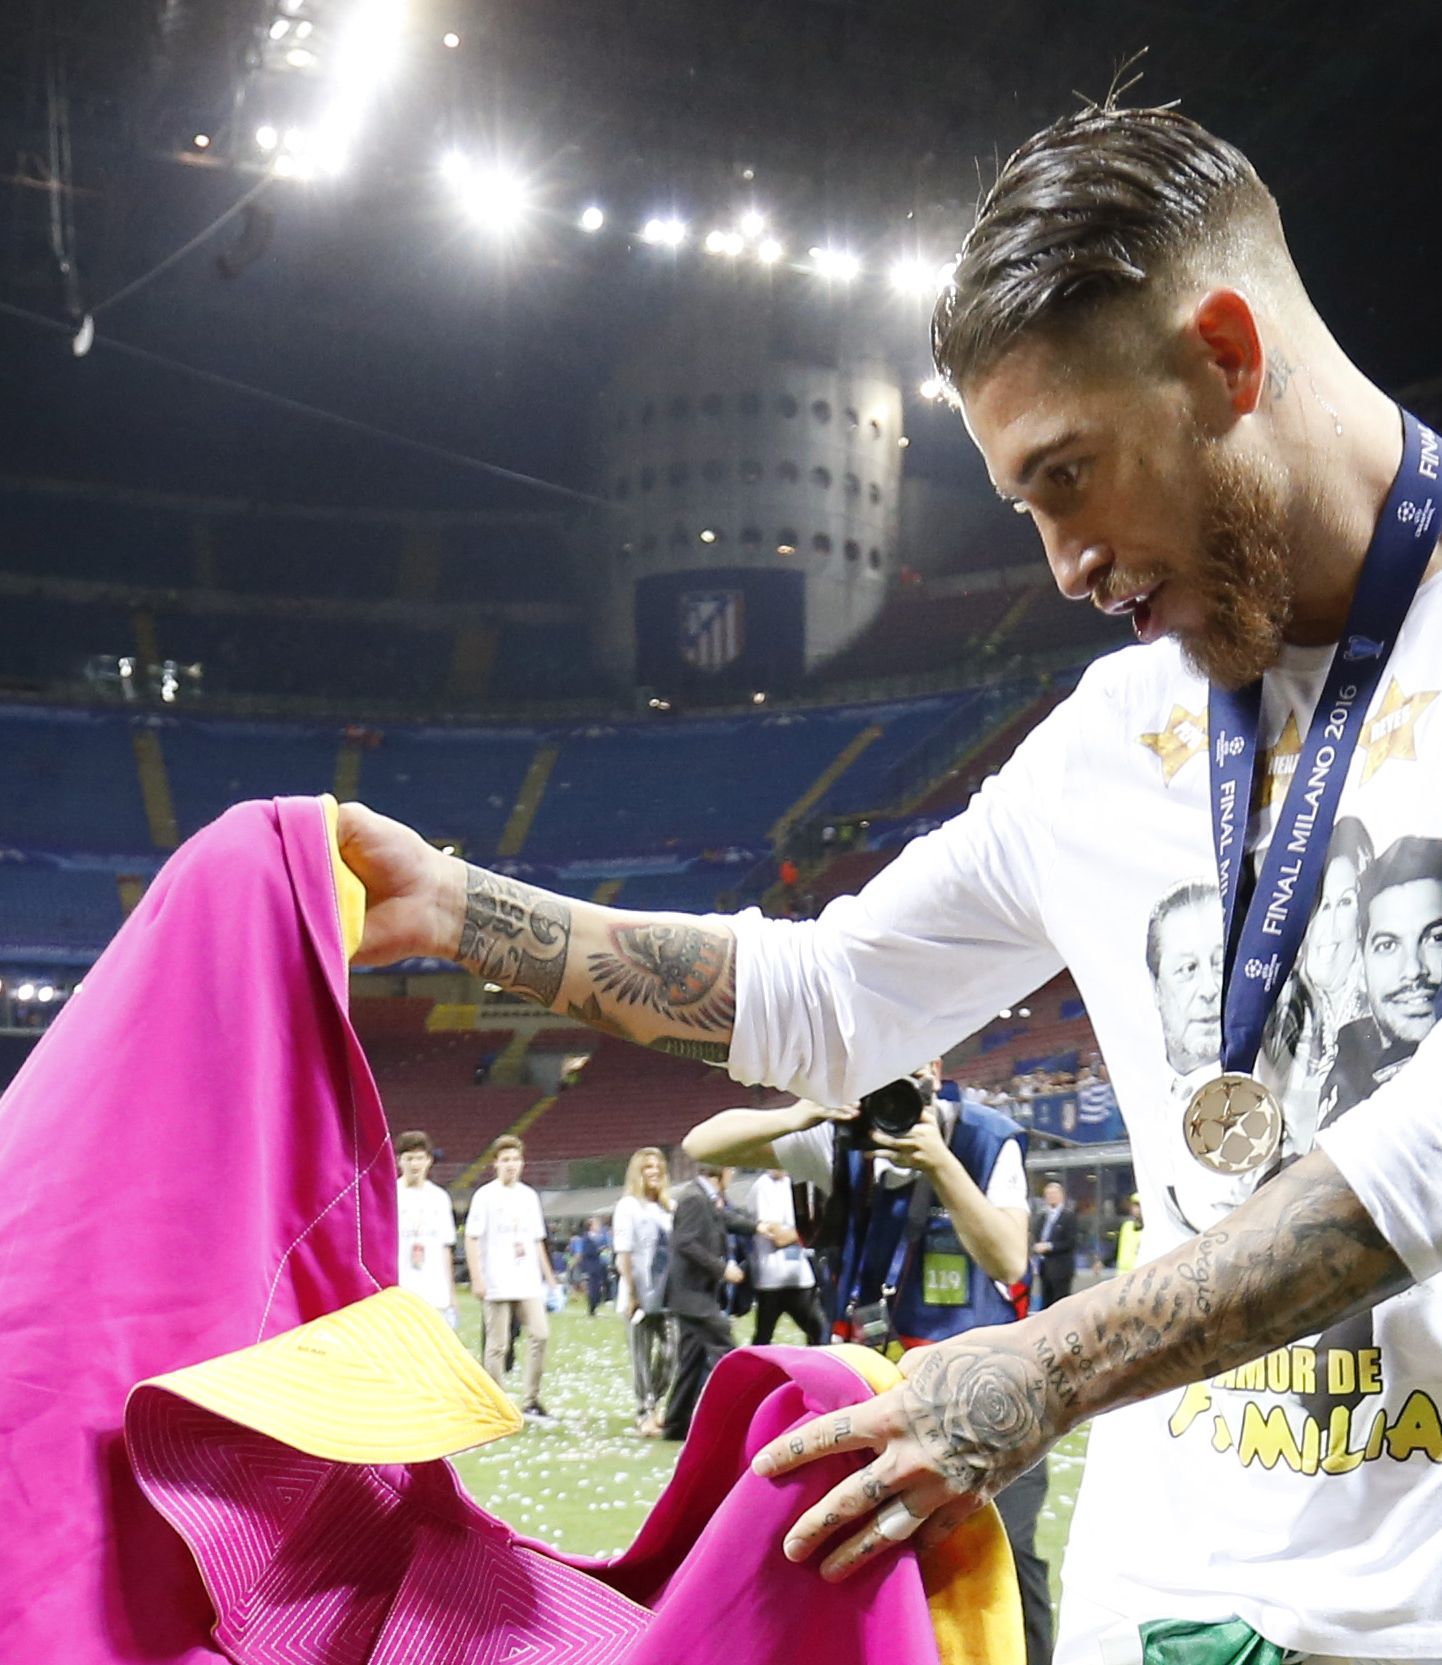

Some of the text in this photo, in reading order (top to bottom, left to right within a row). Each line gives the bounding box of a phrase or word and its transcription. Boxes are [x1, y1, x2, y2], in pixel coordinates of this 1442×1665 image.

[1219, 779, 1236, 857] FINAL
[1262, 859, 1303, 936] FINAL
[1286, 745, 1336, 853] MILANO
[1324, 684, 1358, 741] 2016
[927, 1269, 962, 1290] 119
[1327, 1346, 1383, 1396] DE
